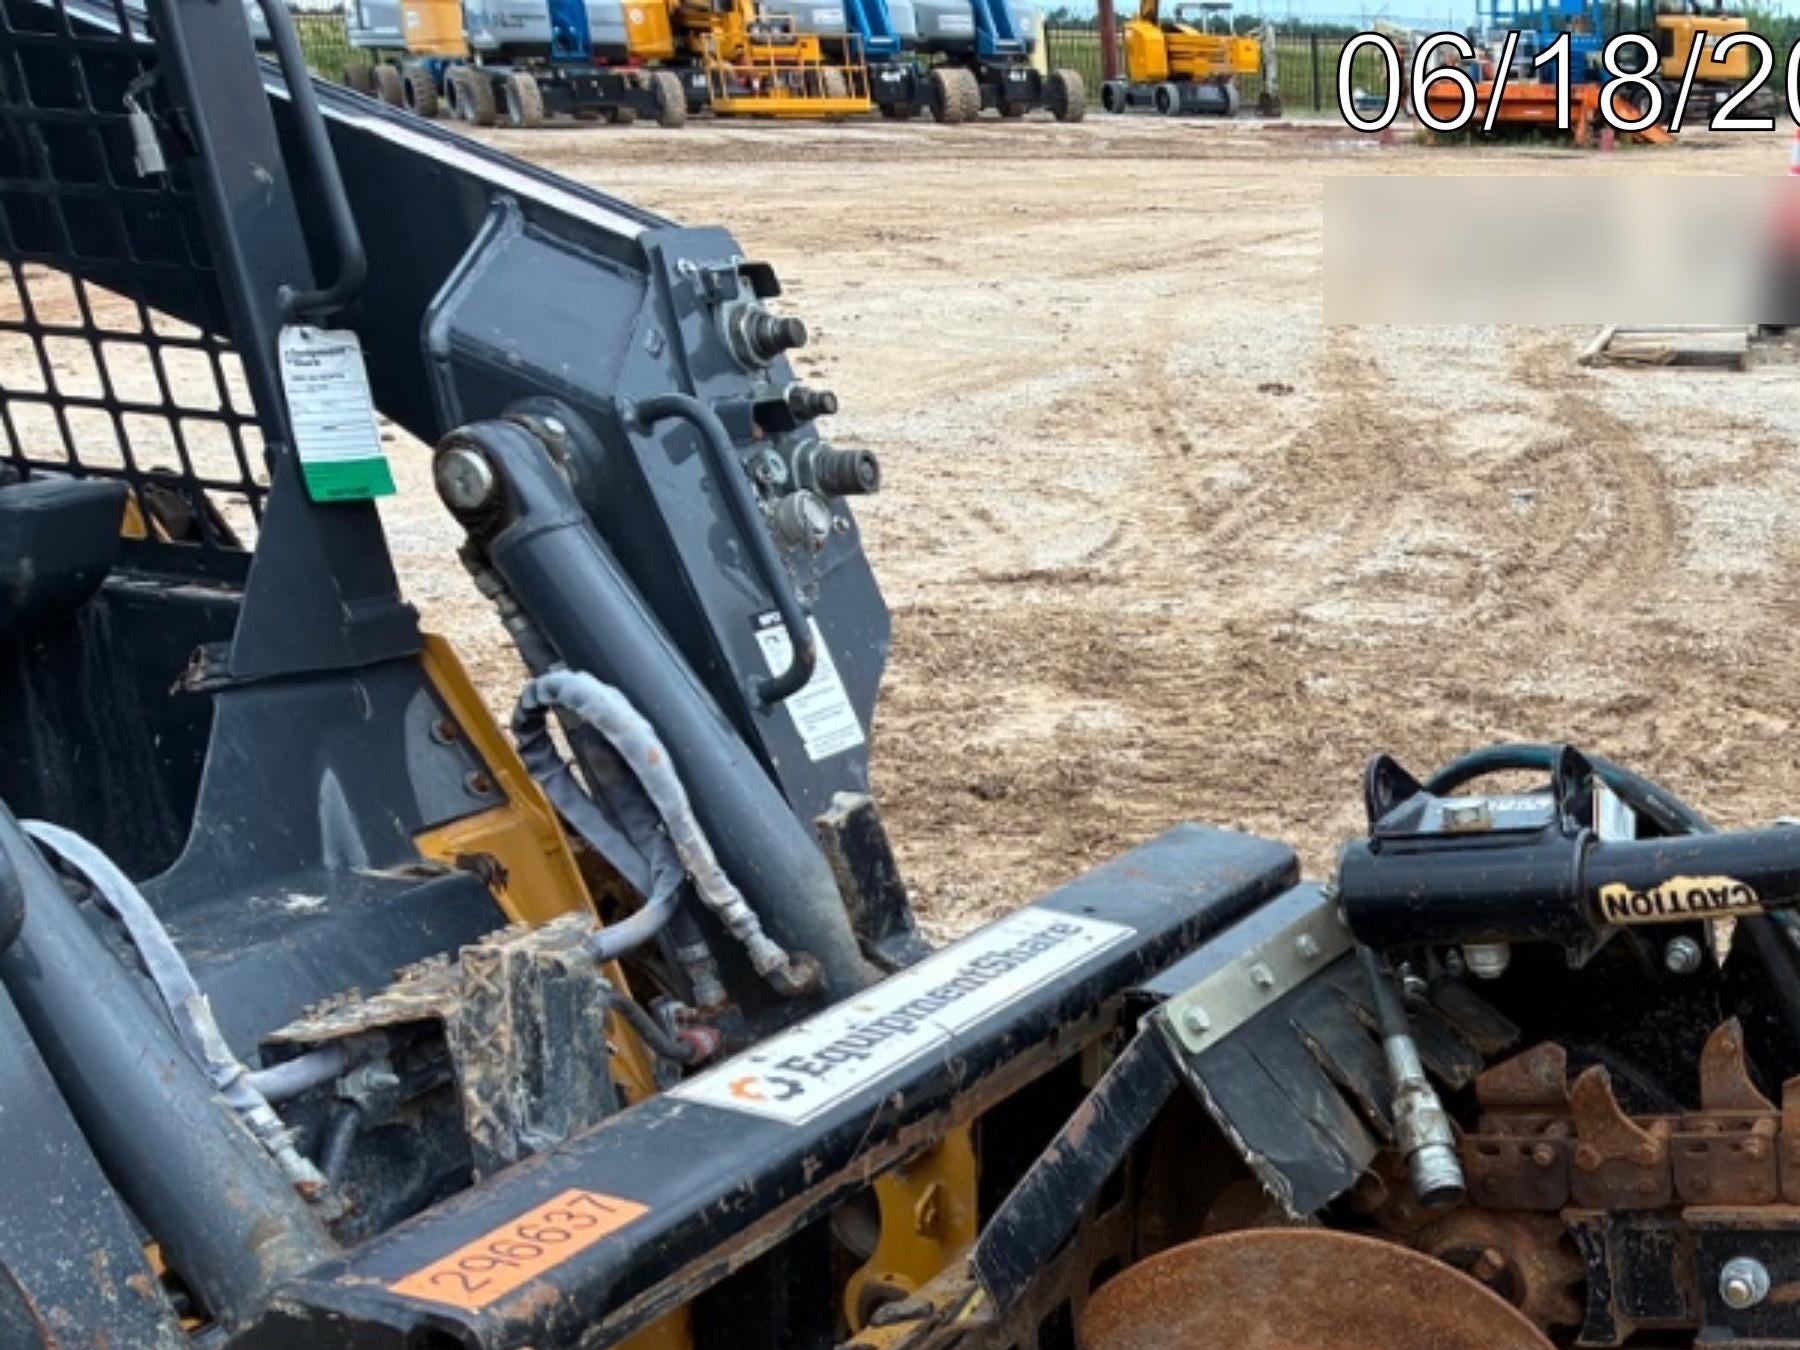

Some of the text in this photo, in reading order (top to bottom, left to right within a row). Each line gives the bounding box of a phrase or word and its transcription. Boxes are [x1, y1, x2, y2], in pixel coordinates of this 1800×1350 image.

[1605, 886, 1755, 918] CAUTION
[803, 923, 1083, 1079] EquipmentShare
[430, 1192, 617, 1293] 296637
